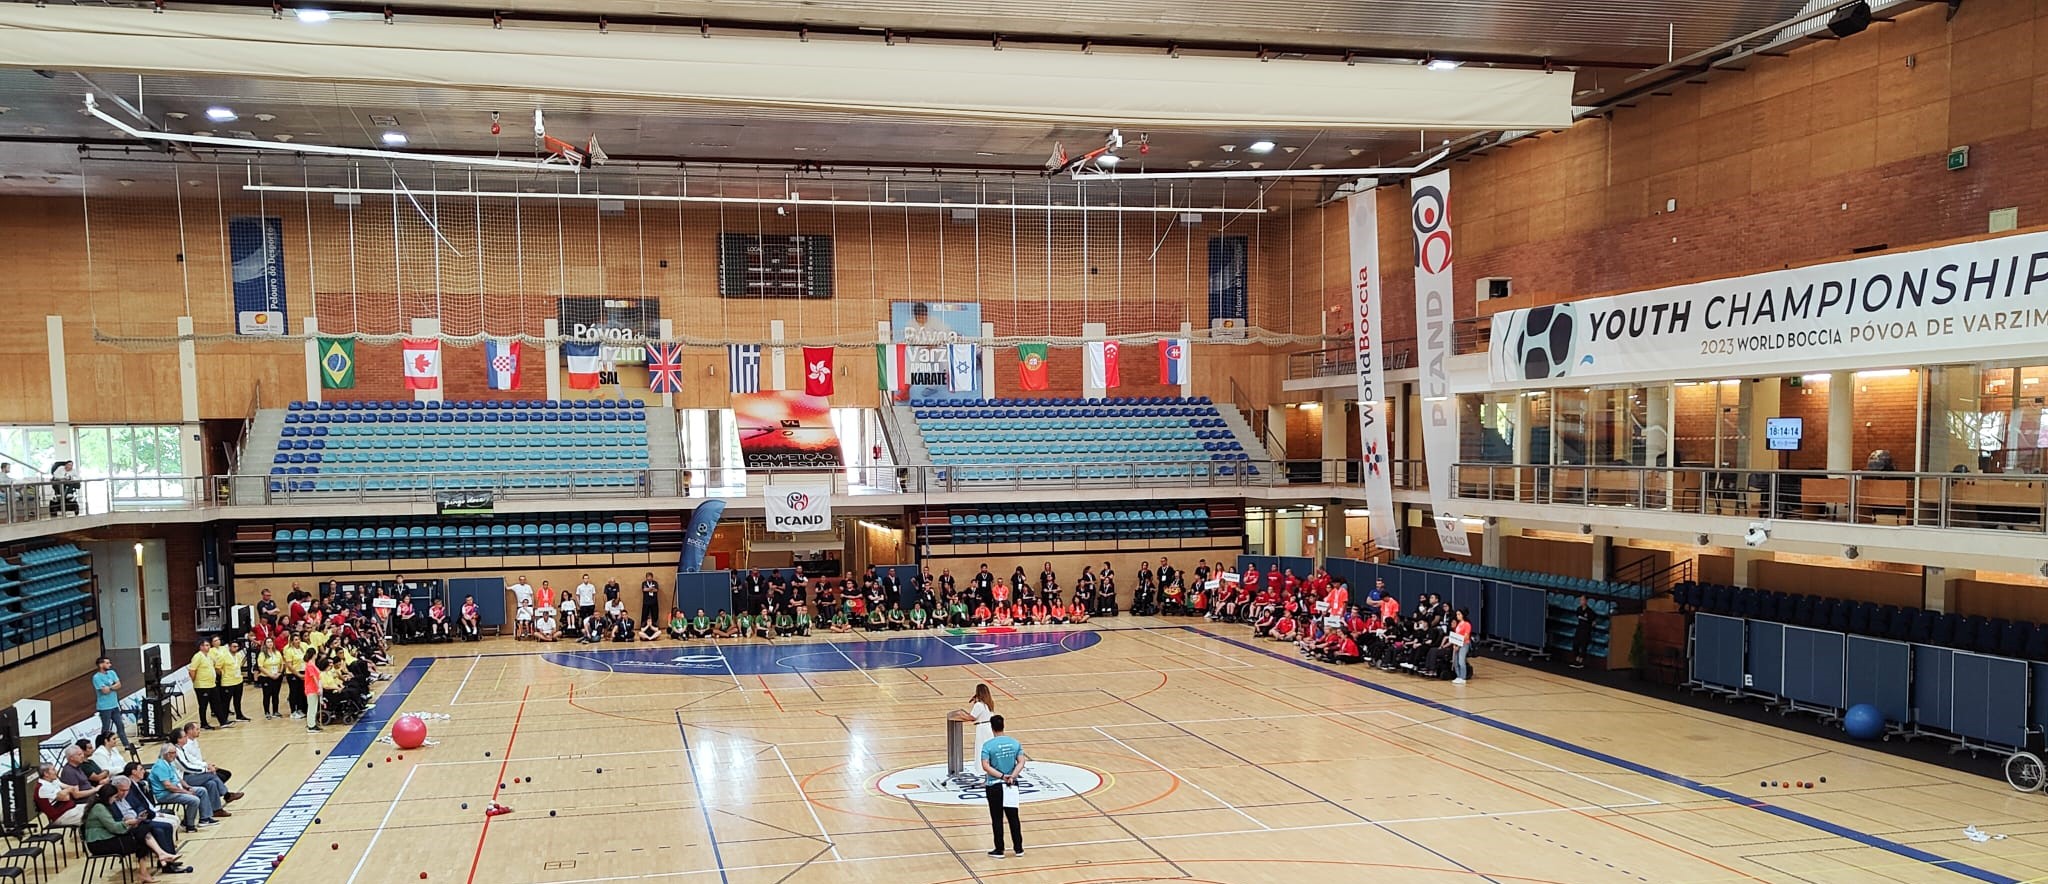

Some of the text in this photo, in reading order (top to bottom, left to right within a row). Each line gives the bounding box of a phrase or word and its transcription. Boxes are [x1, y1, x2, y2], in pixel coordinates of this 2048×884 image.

[267, 265, 277, 277] do
[270, 278, 279, 309] Pelouro
[1590, 251, 2048, 342] YOUTH CHAMPIONSHIP
[573, 323, 633, 342] Póvoa
[1701, 338, 1735, 356] 2023
[1850, 320, 1918, 343] PÓVOA
[1927, 317, 1954, 336] DE
[1963, 307, 2048, 332] VARZIM
[1426, 290, 1447, 427] PCAND
[748, 452, 833, 462] COMPETIÇÃO
[775, 515, 824, 526] PCAND
[24, 709, 38, 729] 4
[147, 703, 156, 735] DONIC
